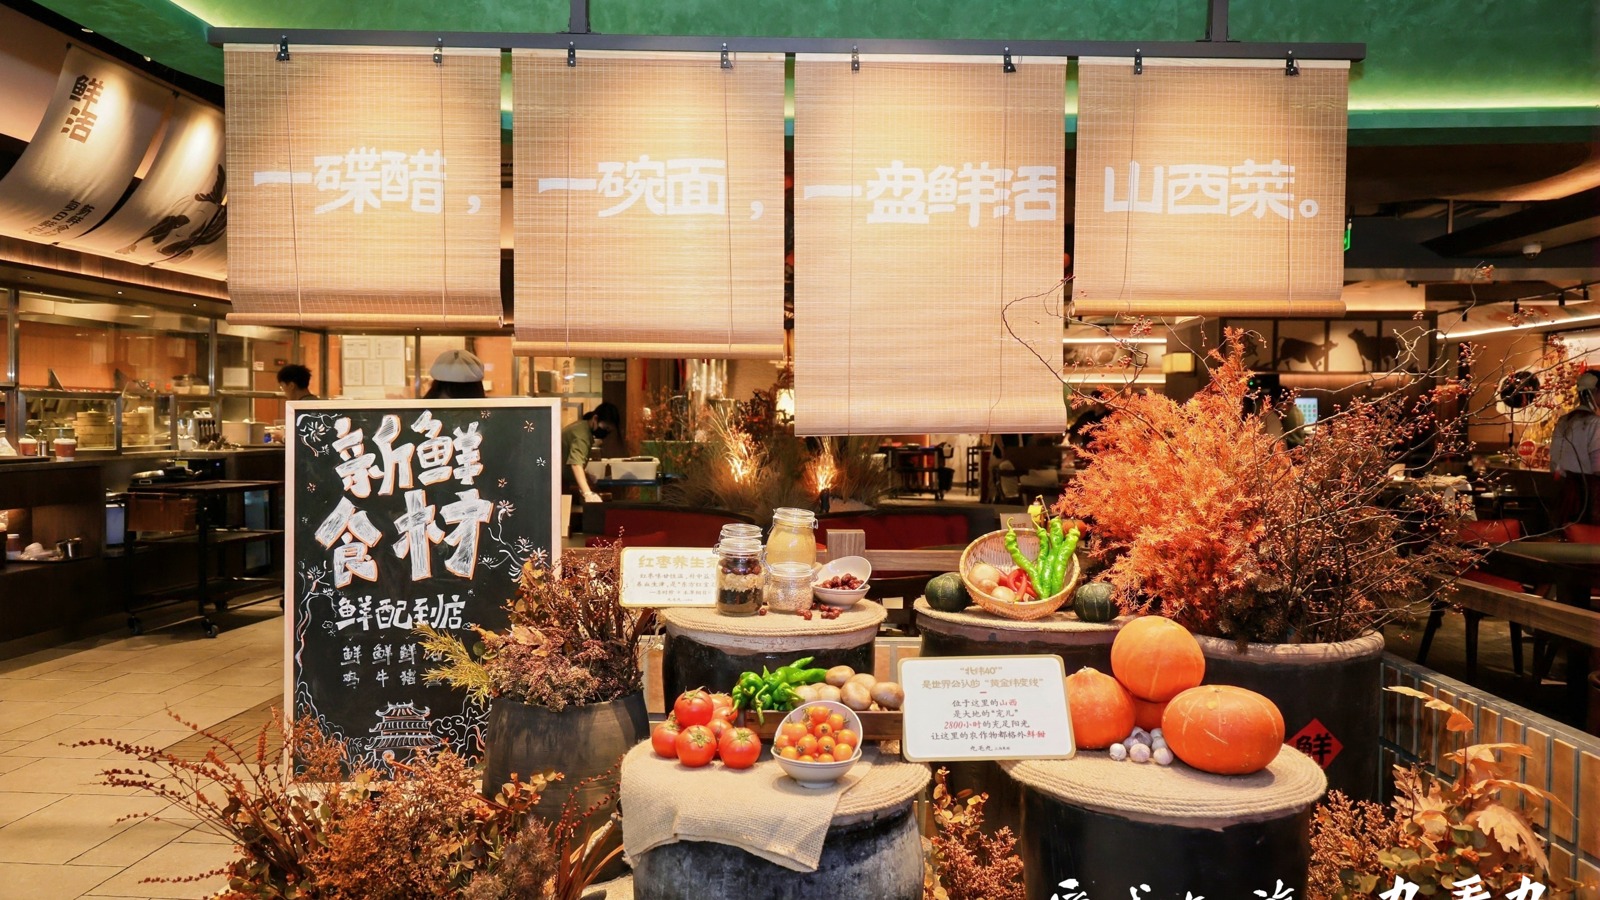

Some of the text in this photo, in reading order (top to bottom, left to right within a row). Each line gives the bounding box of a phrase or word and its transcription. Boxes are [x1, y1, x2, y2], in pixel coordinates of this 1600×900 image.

[60, 74, 104, 144] 鲜活
[804, 160, 1057, 227] 一盘鲜活
[332, 409, 483, 498] 新鲜
[314, 488, 494, 588] 食材
[335, 593, 466, 631] 鲜配到店
[944, 720, 1030, 730] 2800小时的充足阳光
[952, 699, 1018, 708] 位于这里的山西
